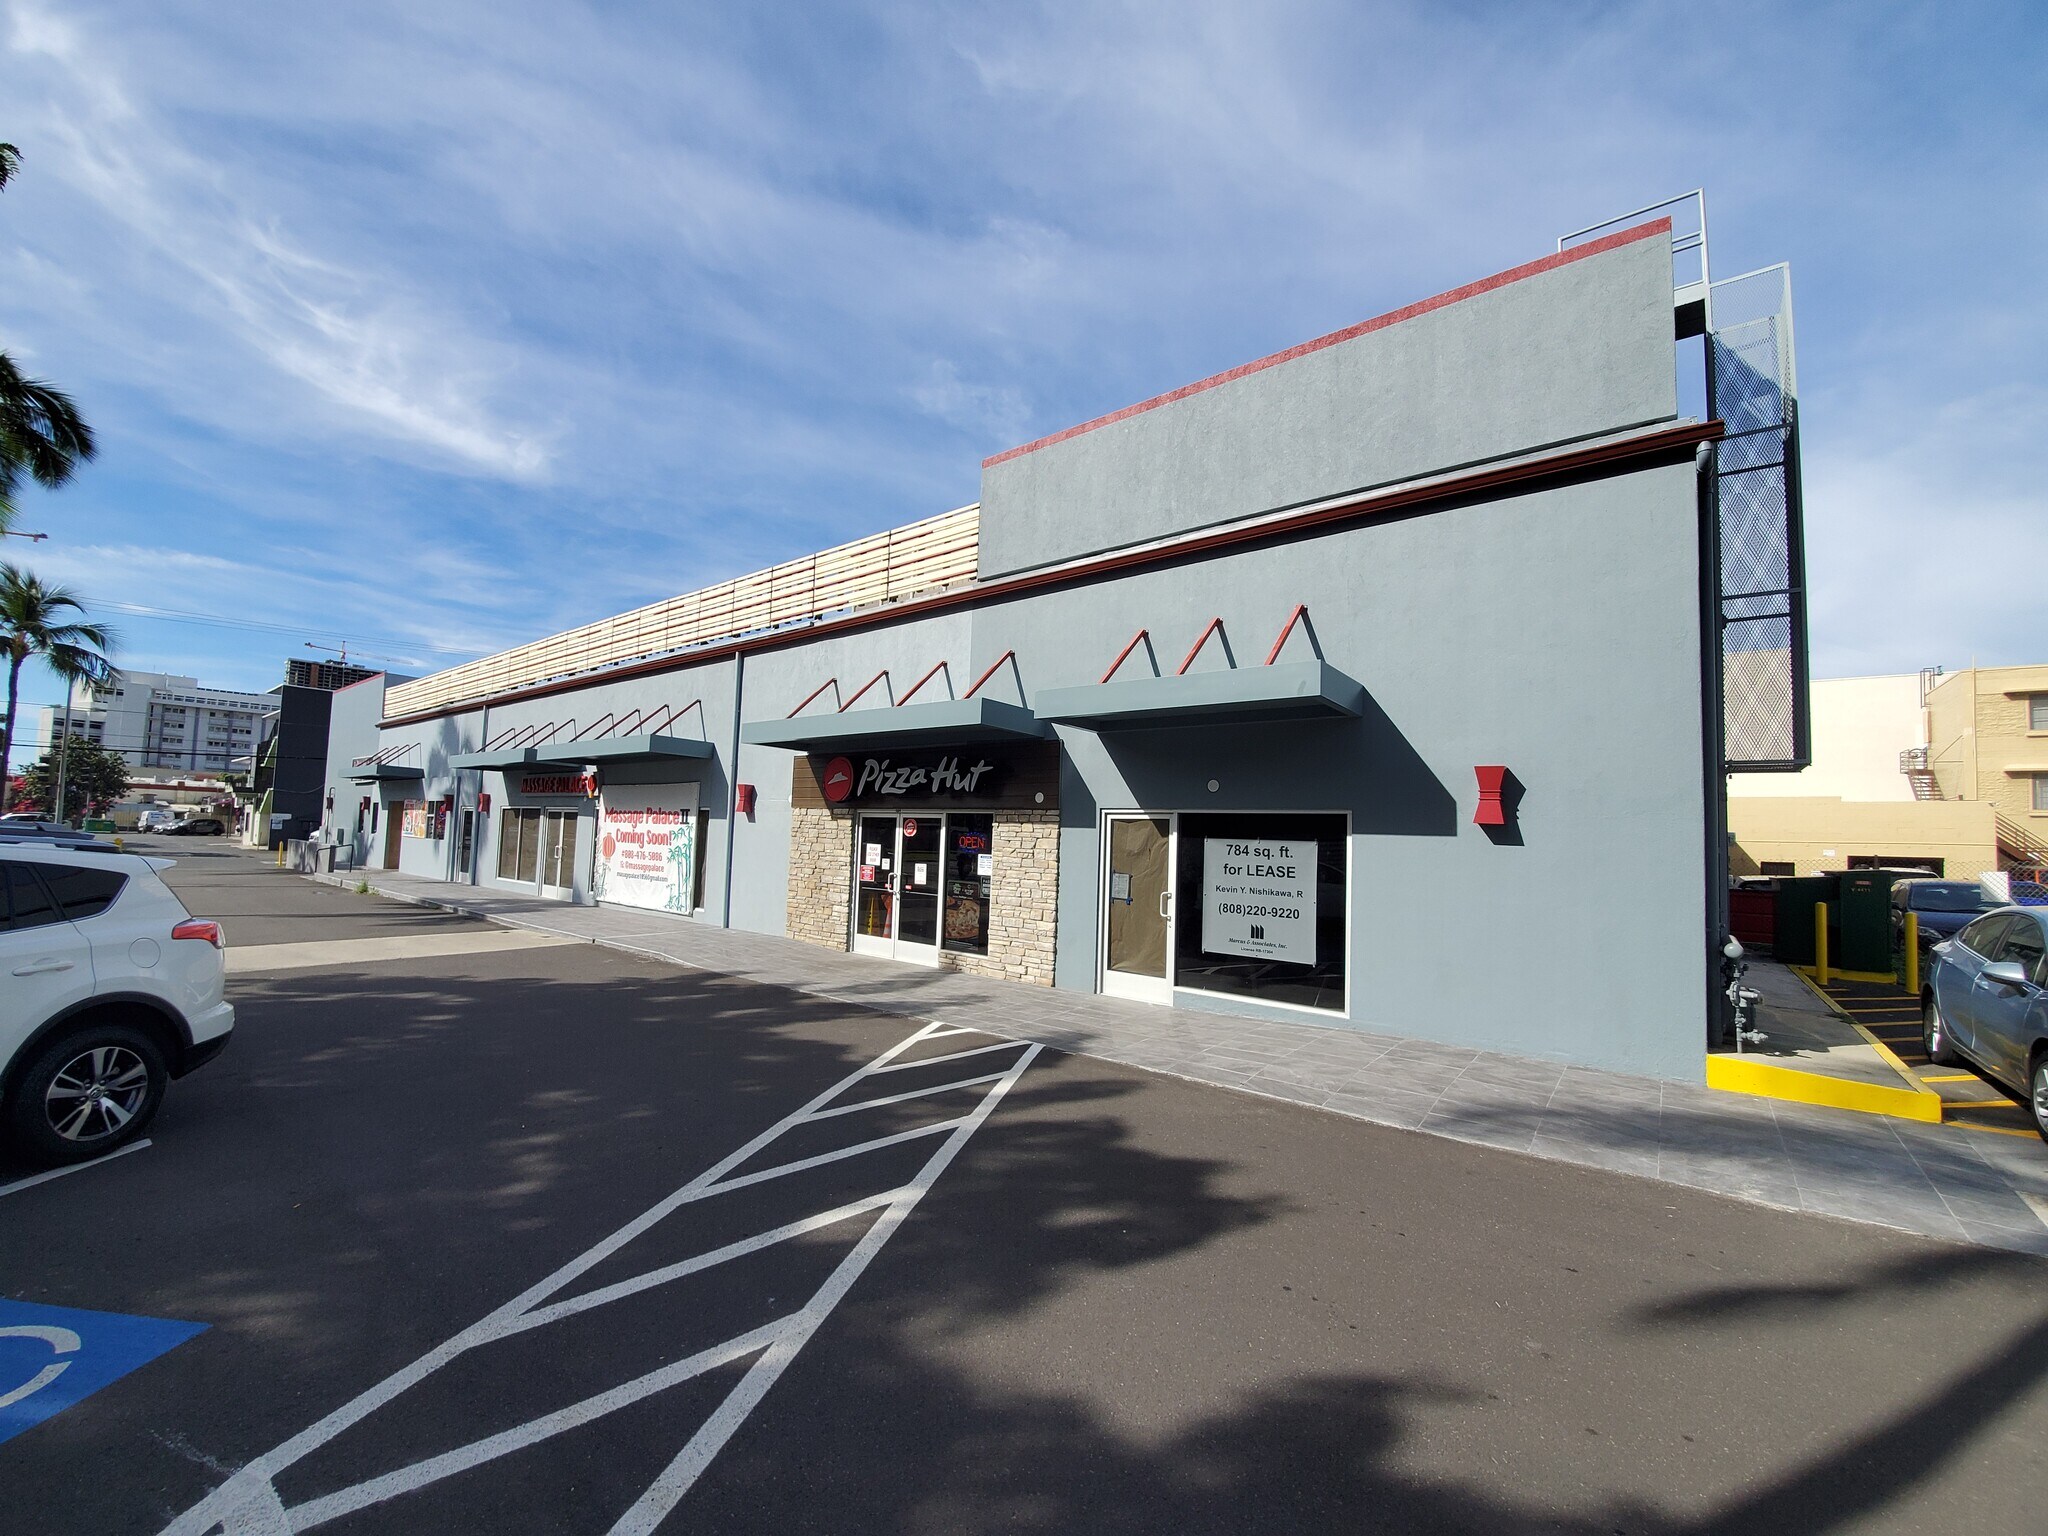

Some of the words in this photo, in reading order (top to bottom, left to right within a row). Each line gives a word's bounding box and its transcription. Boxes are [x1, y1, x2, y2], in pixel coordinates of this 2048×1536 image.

[857, 758, 928, 797] Pizza
[930, 756, 994, 793] Hut
[604, 807, 644, 828] Massage
[645, 807, 680, 825] Palace
[680, 808, 690, 824] II
[616, 828, 645, 849] Coming
[646, 829, 672, 846] Soon!
[959, 836, 986, 849] OPEN
[1226, 844, 1250, 857] 784
[1253, 847, 1275, 860] sq.
[1279, 845, 1294, 858] ft.
[1223, 863, 1243, 875] for
[1246, 864, 1296, 879] LEASE
[1215, 884, 1238, 894] Kevin
[1239, 886, 1247, 894] Y.
[1249, 887, 1294, 898] Nishikawa,
[1296, 890, 1304, 898] R
[1218, 902, 1300, 920] (808)220-9220
